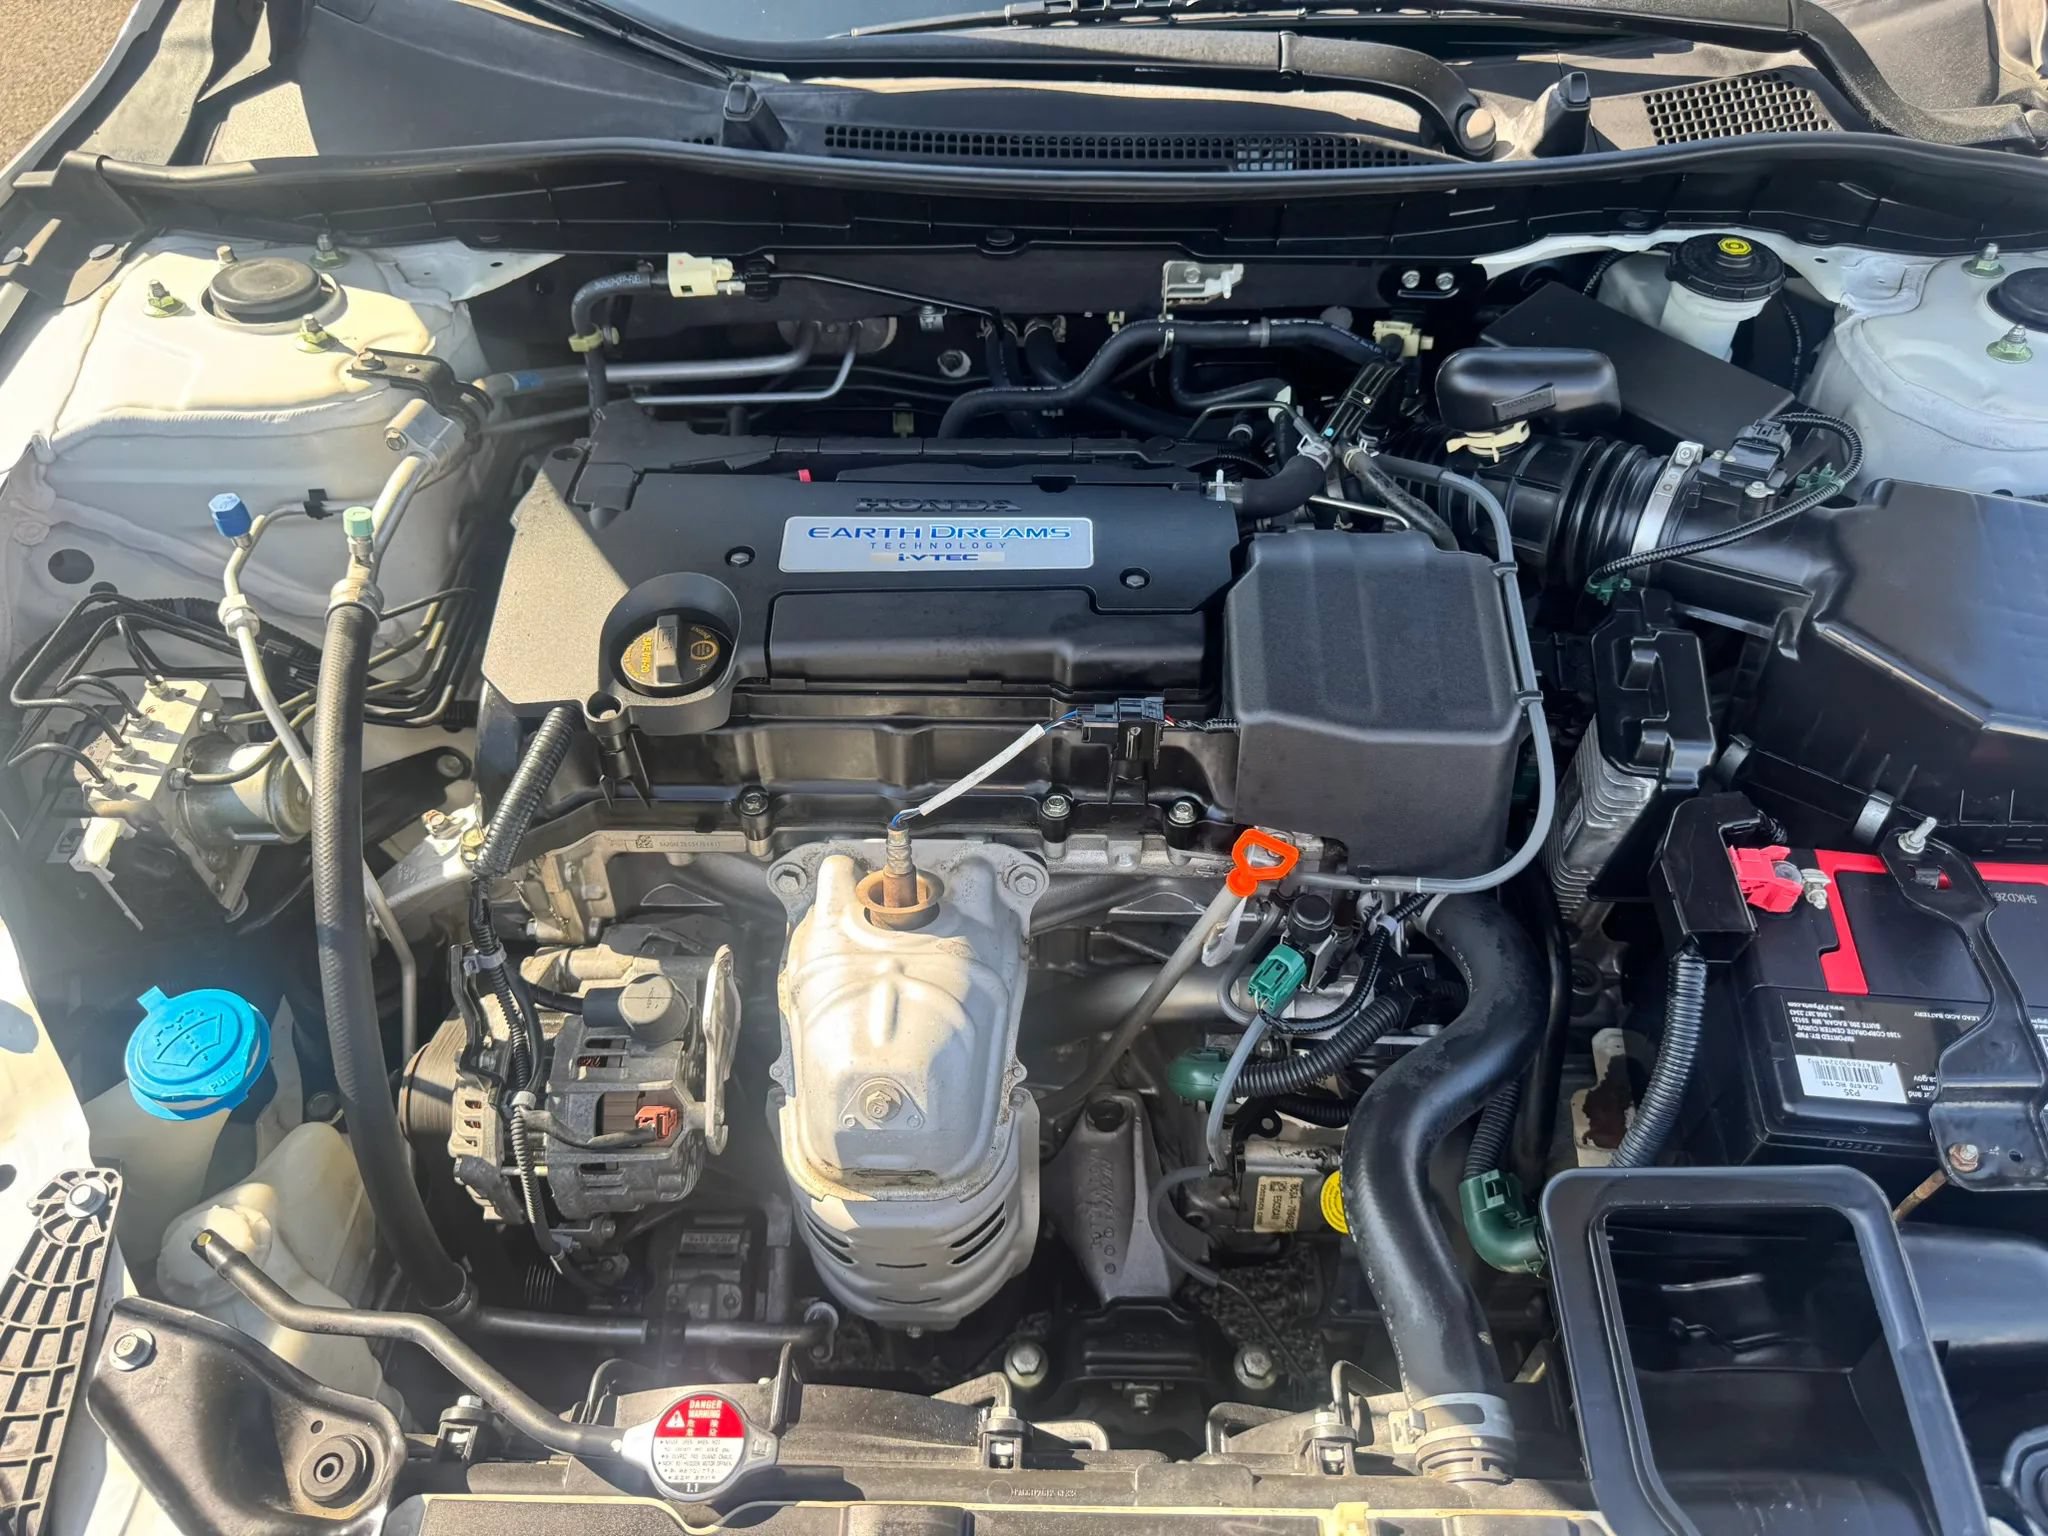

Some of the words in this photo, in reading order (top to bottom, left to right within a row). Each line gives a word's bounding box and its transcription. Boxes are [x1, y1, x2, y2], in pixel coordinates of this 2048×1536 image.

[855, 497, 1022, 513] HONDA
[808, 526, 921, 539] EARTH
[930, 525, 1071, 539] DREAMS
[870, 542, 1007, 550] TECHNOLOGY
[898, 553, 979, 561] i-VTEC
[1914, 1011, 1944, 1019] BATTERY
[1820, 1026, 1845, 1034] CENTER
[1846, 1028, 1885, 1037] CORPORATE
[209, 1071, 241, 1092] PULL
[1862, 1083, 1879, 1091] CCA
[1843, 1088, 1861, 1097] P35
[689, 1400, 722, 1409] DANGER
[688, 1410, 721, 1418] WARNING
[686, 1482, 699, 1493] 1.1
